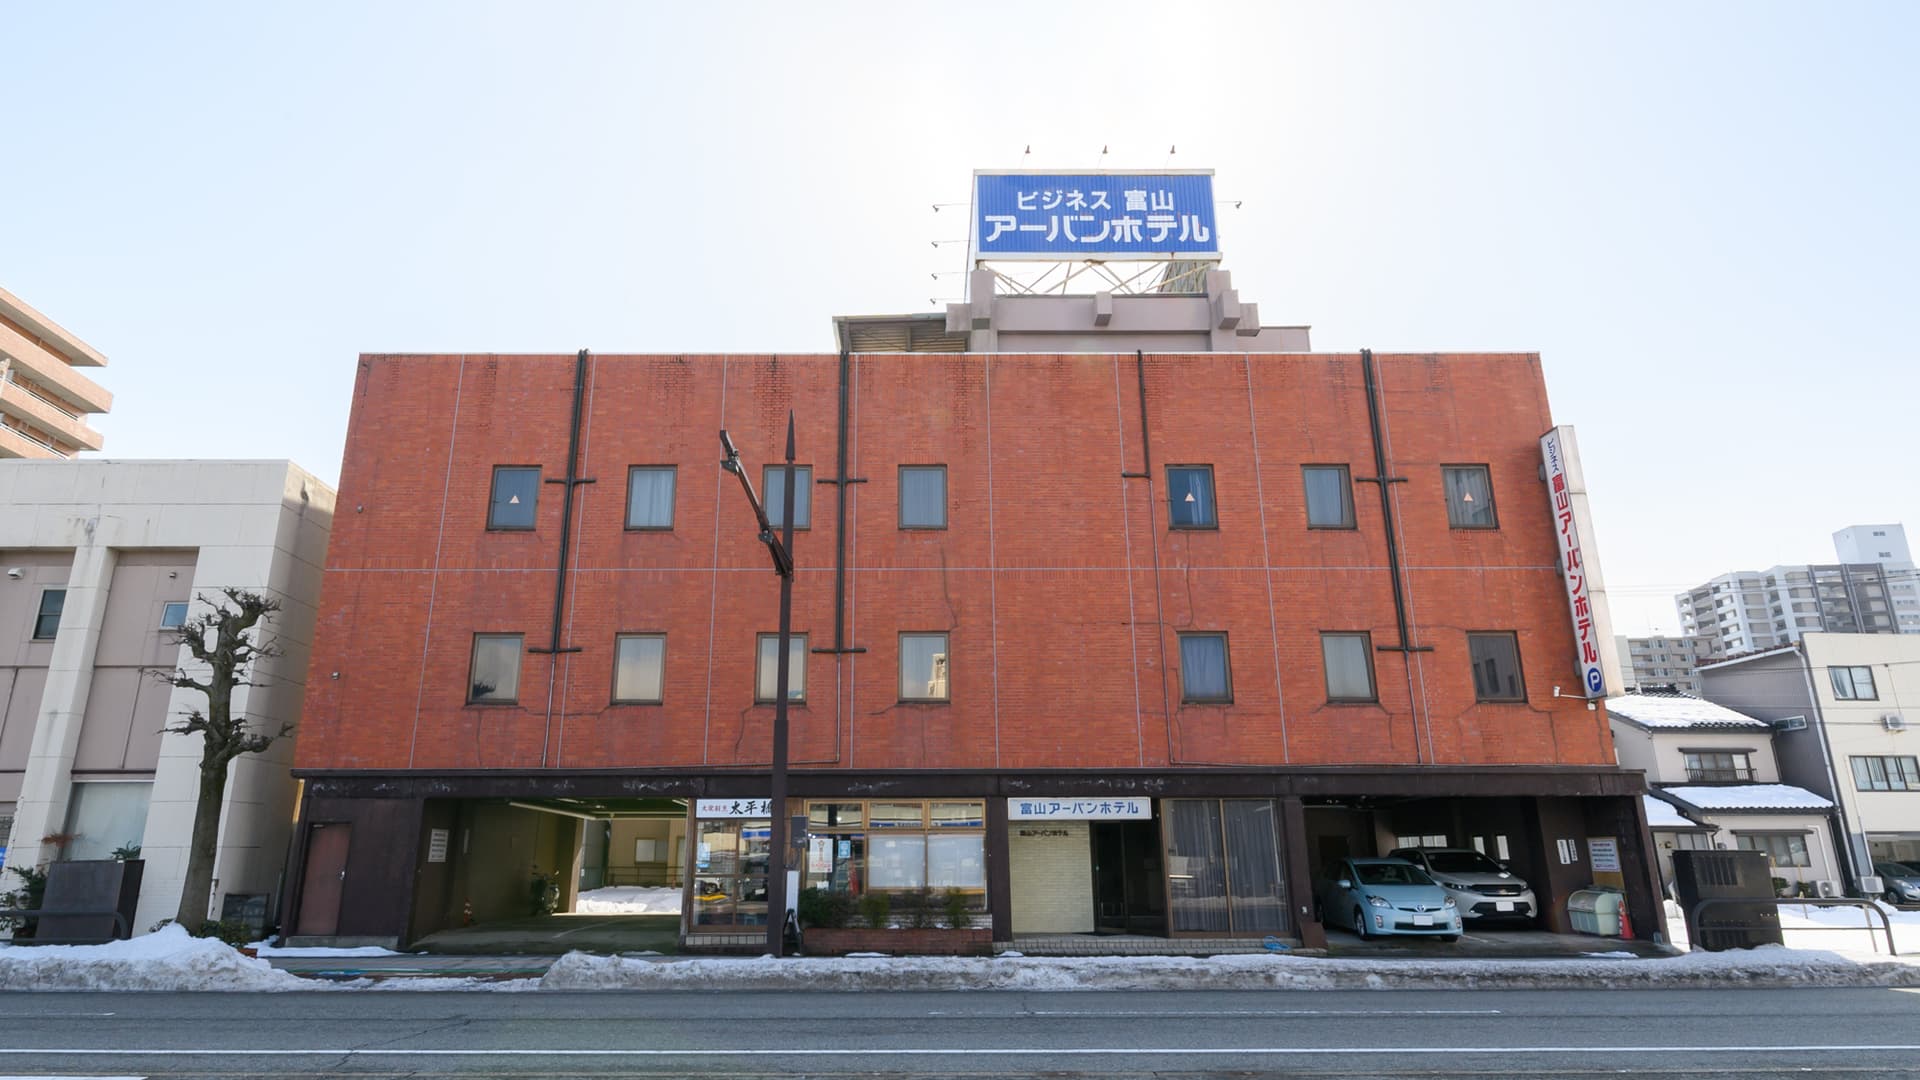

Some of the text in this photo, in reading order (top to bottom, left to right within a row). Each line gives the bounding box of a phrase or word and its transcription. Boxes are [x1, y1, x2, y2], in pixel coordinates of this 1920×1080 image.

[1017, 189, 1174, 211] ビジネス 富山
[984, 215, 1210, 243] アーバンホテル
[1551, 473, 1598, 664] 富山アーバンホテル
[1020, 801, 1139, 815] 富山アーバンホテル
